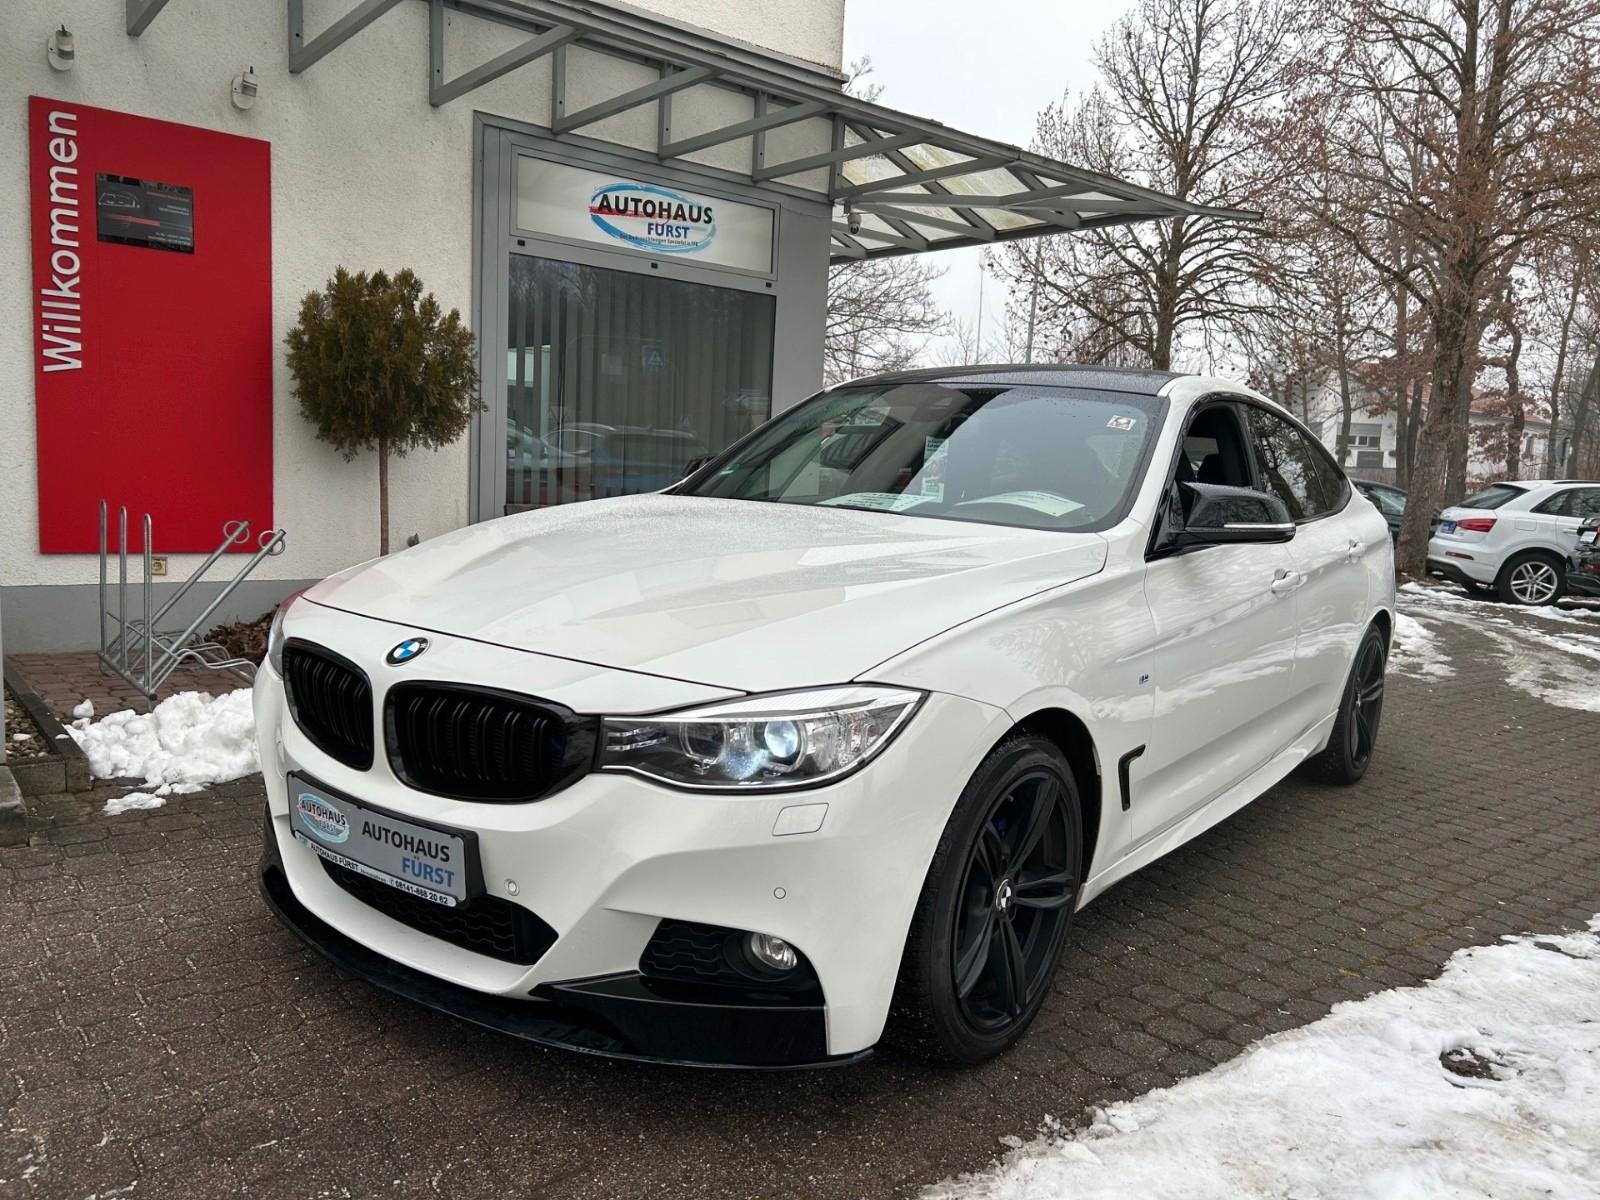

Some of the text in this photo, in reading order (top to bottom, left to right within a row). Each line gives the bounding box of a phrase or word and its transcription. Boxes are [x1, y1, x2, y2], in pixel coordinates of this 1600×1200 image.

[598, 194, 713, 225] AUTOHAUS
[41, 110, 82, 373] Willkommen
[301, 800, 346, 825] AUTOHAUS
[361, 820, 450, 863] AUTOHAUS
[310, 842, 339, 864] AUTOHAUS
[429, 892, 438, 902] 20
[439, 896, 449, 905] 62
[401, 855, 455, 888] FÜRST
